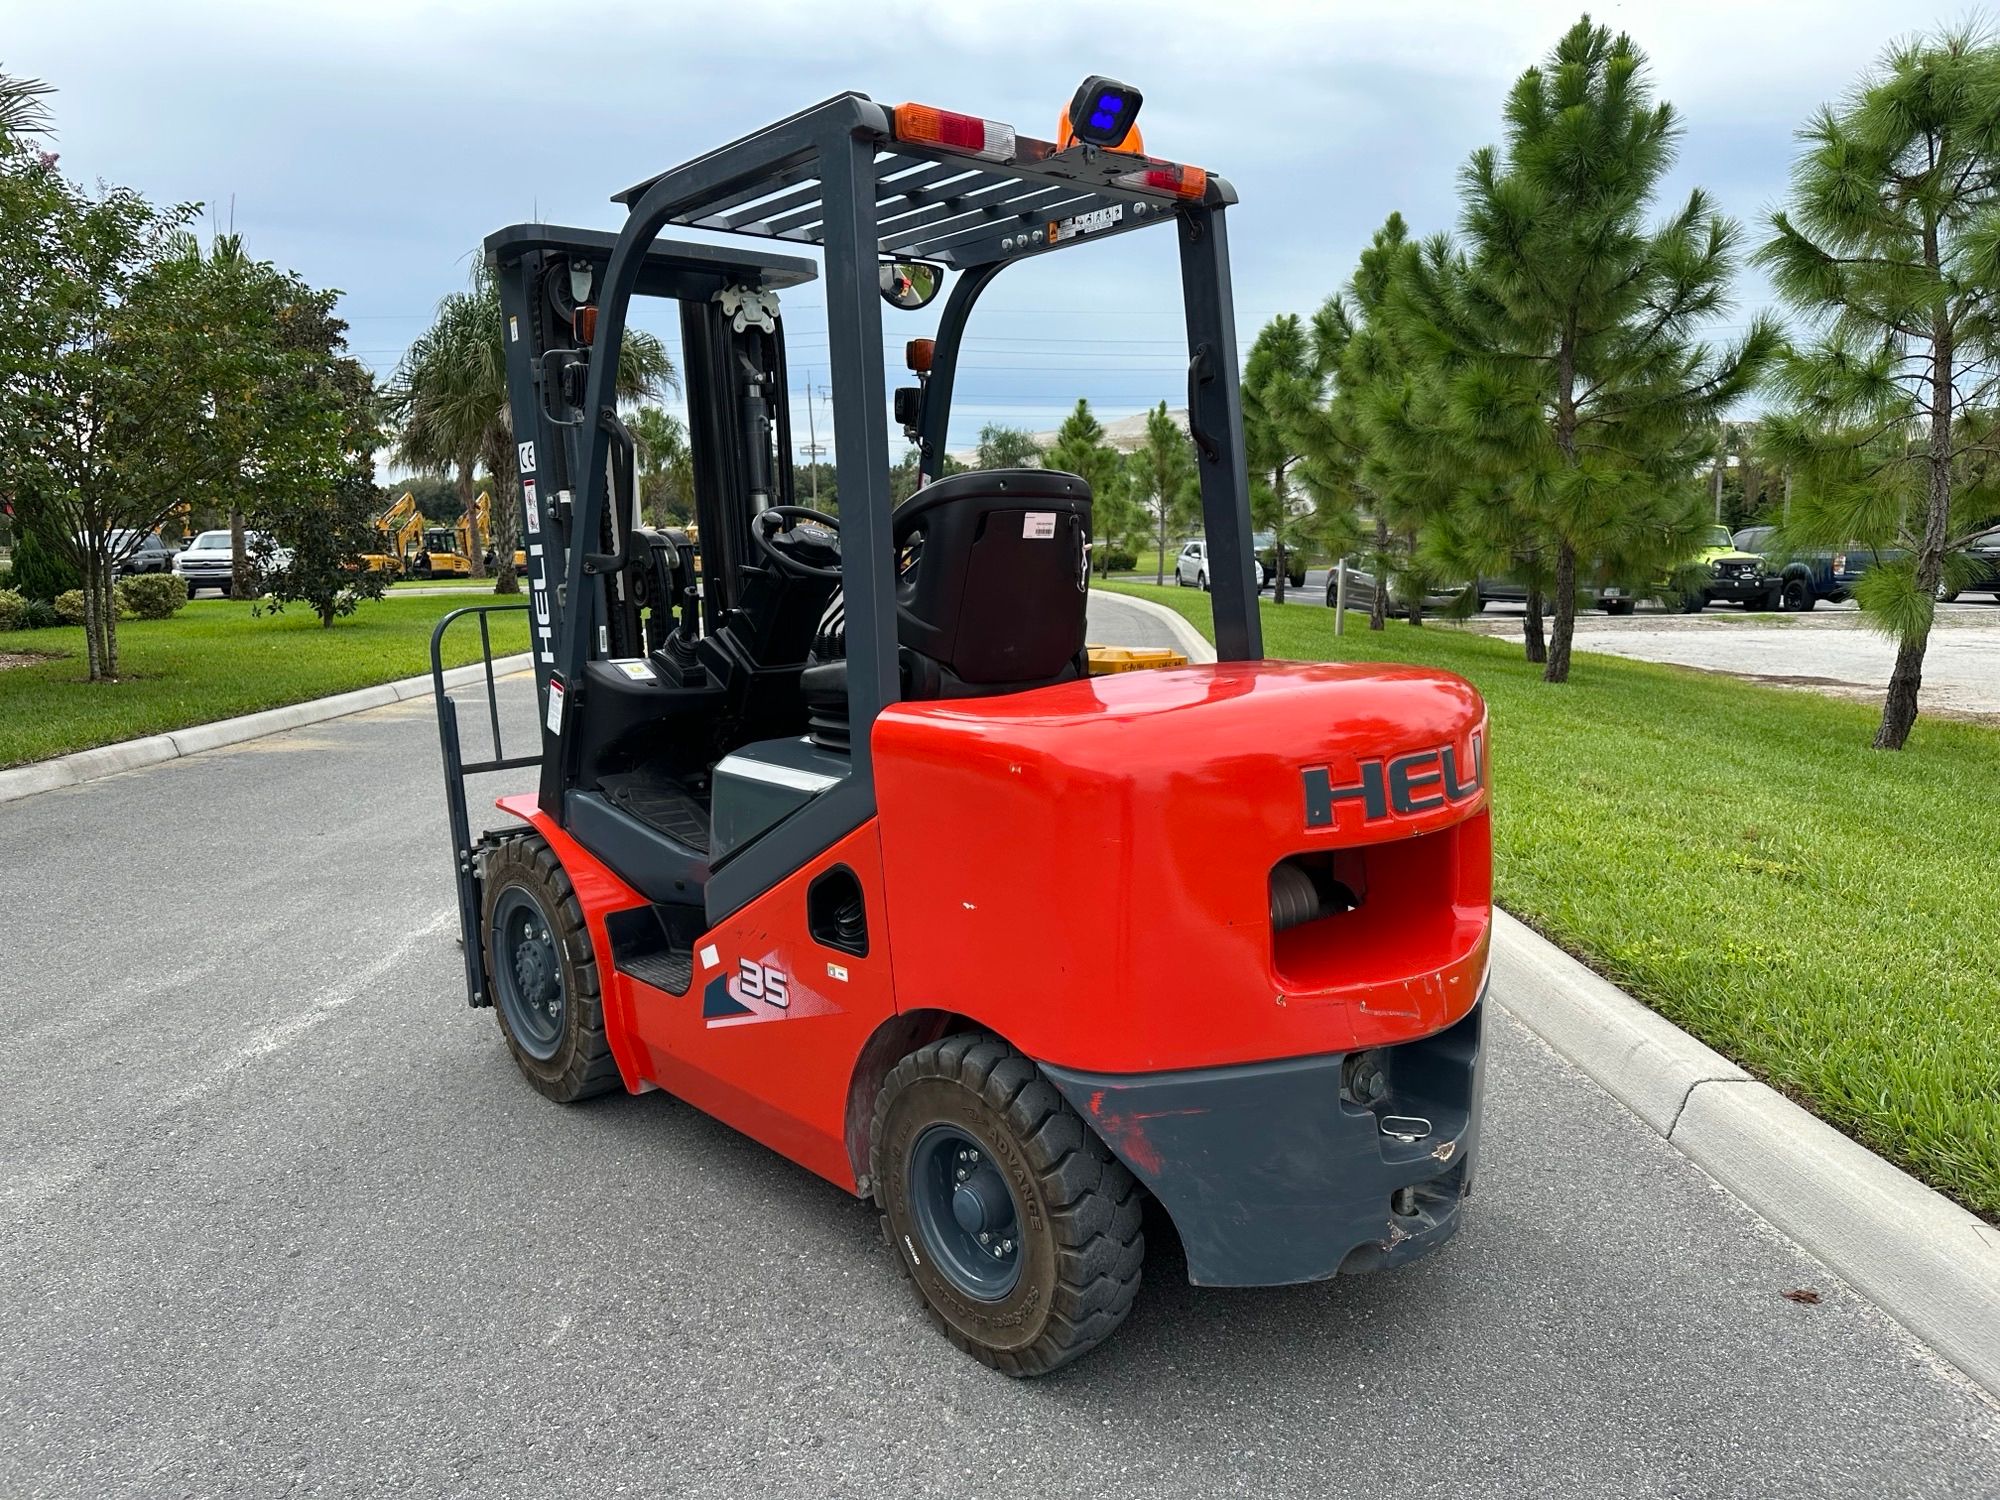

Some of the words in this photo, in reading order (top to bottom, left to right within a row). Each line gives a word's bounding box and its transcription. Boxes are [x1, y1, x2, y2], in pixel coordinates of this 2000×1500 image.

[521, 445, 535, 469] CE
[530, 544, 555, 664] HELI
[739, 957, 790, 1010] 35
[986, 1127, 1044, 1233] ADVANCE
